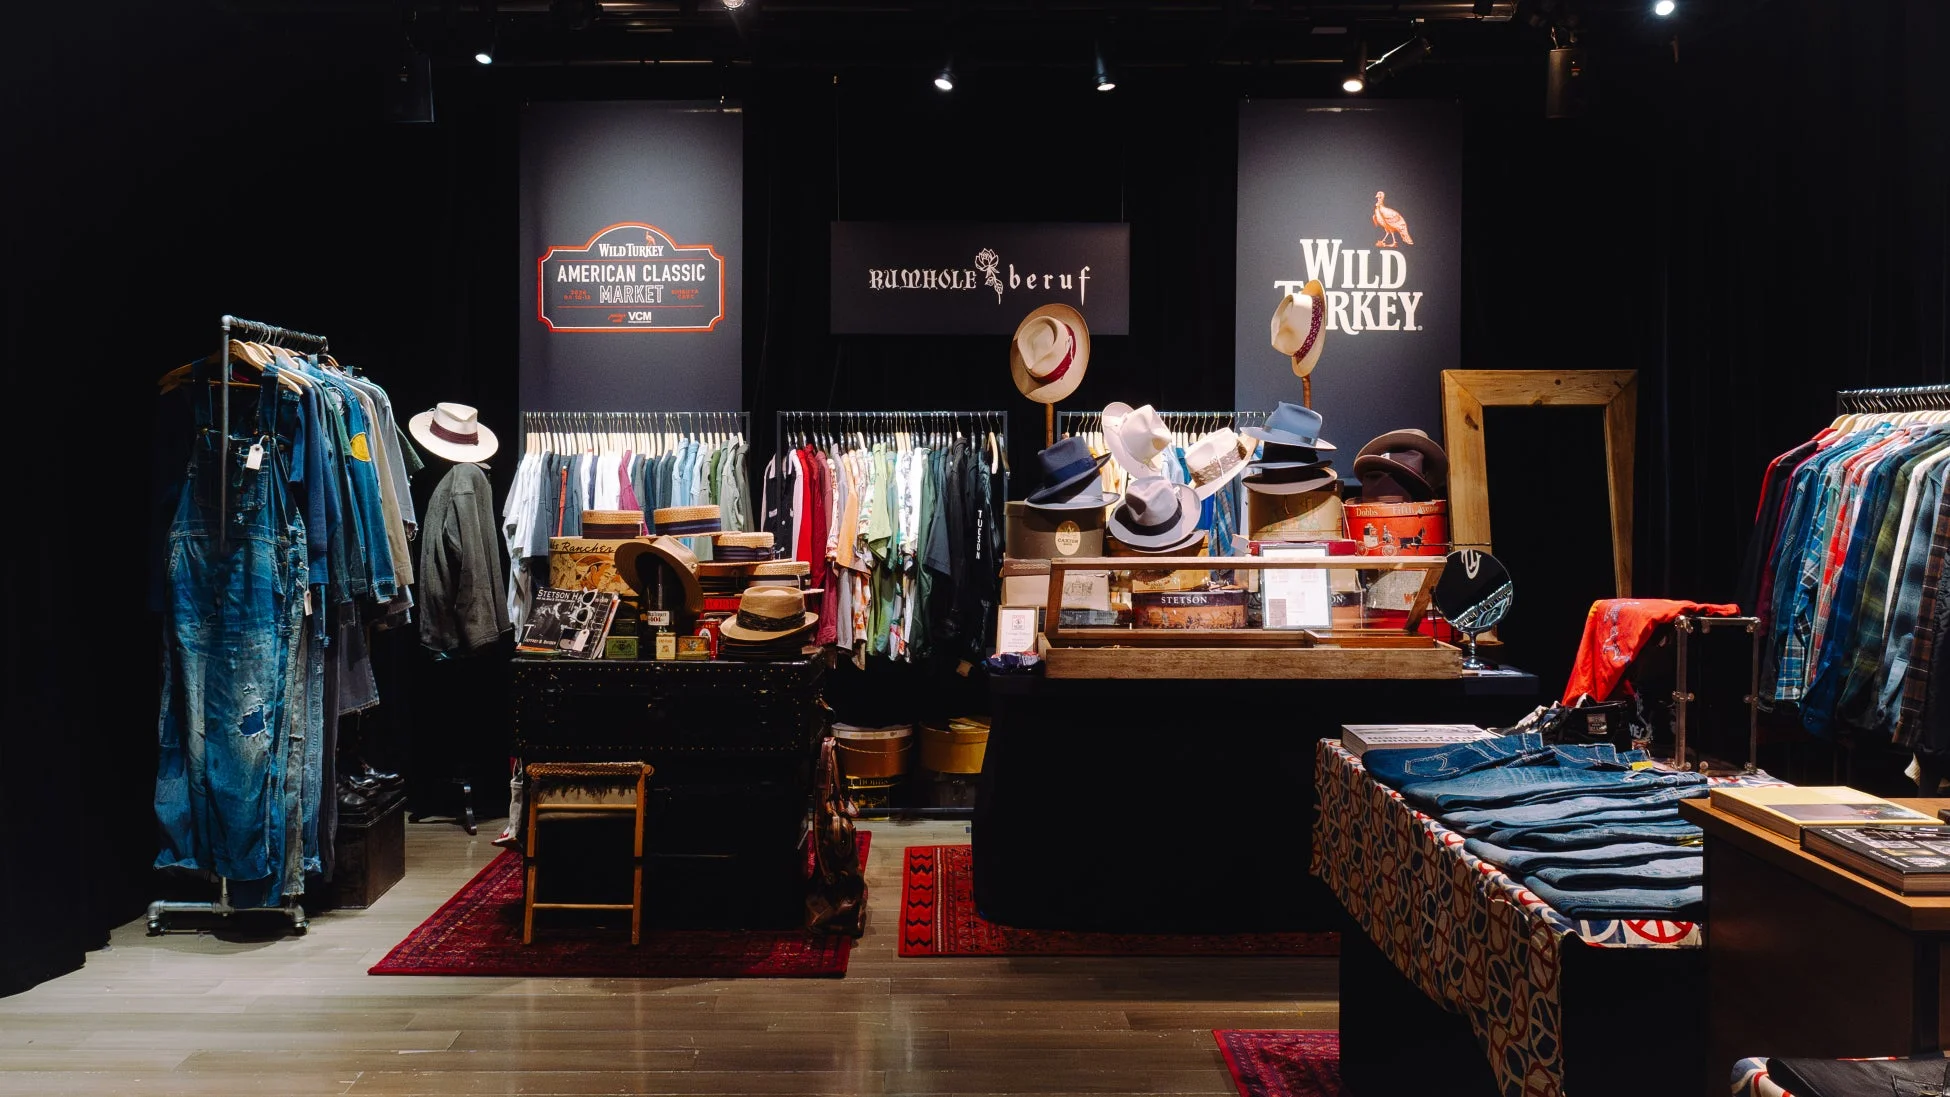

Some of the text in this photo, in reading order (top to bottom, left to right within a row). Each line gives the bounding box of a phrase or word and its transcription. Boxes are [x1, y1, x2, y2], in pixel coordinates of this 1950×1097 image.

[598, 243, 664, 257] WILD TURKEY
[1300, 239, 1407, 289] WILD
[557, 263, 706, 283] AMERICAN CLASSIC
[868, 263, 1091, 306] RUMHOLE beruf
[599, 285, 664, 304] MARKET
[1273, 280, 1423, 335] TRKEY
[628, 311, 652, 321] VCM
[1356, 507, 1378, 517] Dobbs
[537, 589, 570, 600] STETSON
[1161, 596, 1208, 604] STETSON
